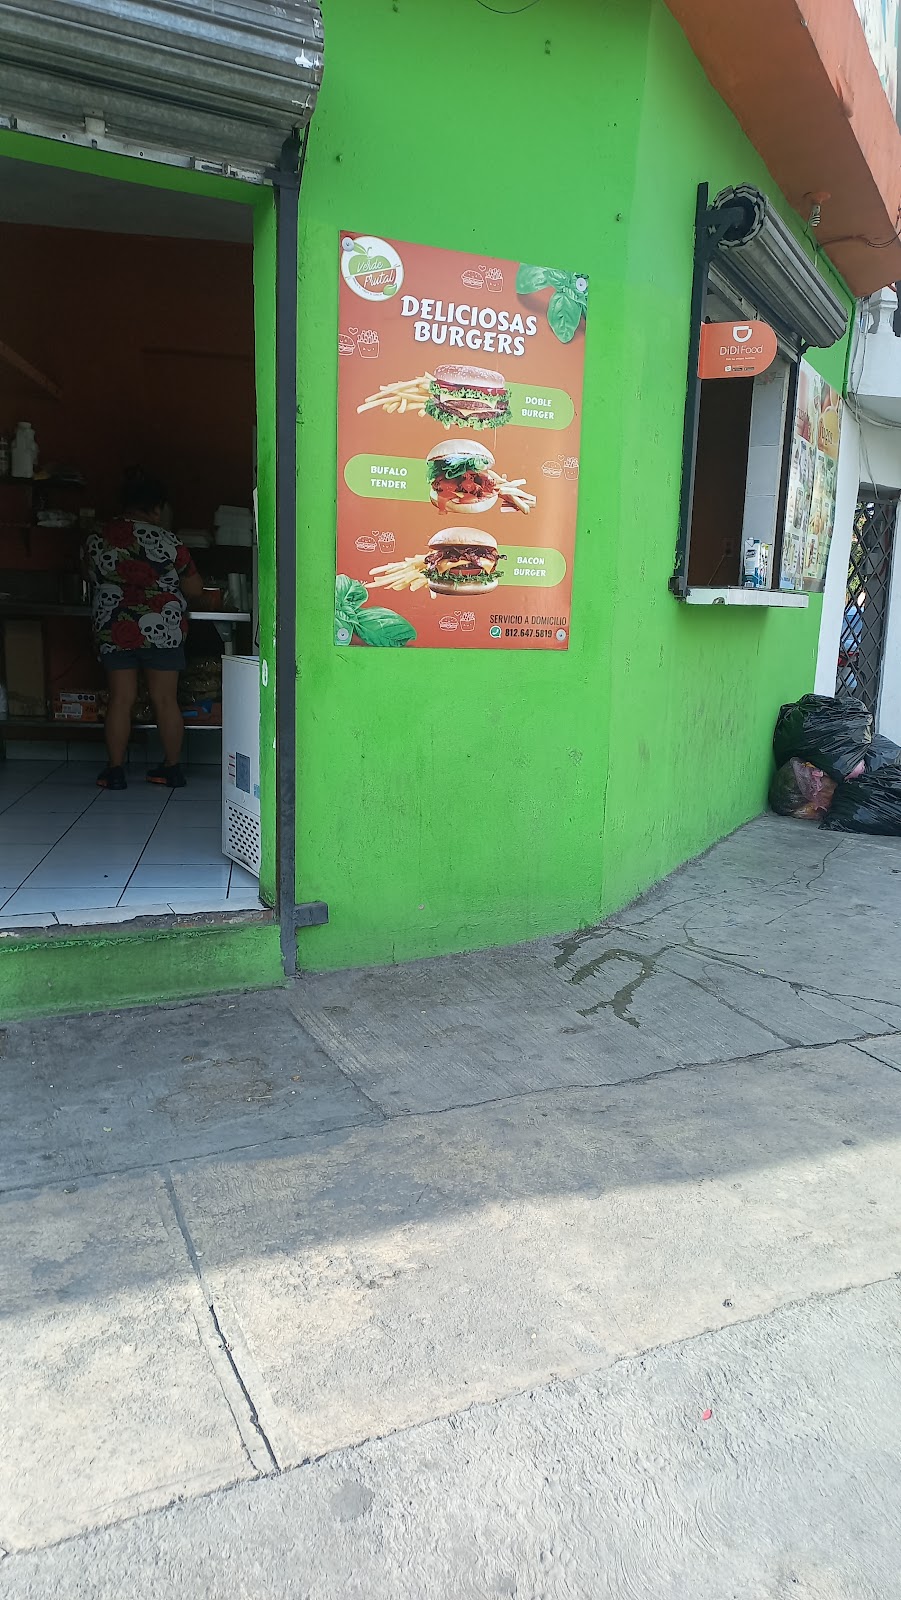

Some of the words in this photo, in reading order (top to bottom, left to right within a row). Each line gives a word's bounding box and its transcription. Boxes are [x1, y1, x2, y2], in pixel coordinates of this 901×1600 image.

[357, 259, 383, 273] Verde
[363, 269, 395, 288] Frutal
[400, 295, 538, 336] DELICIOSAS
[413, 321, 525, 356] BURGERS
[525, 396, 553, 408] DOBLE
[521, 408, 555, 420] BURGER
[370, 465, 408, 477] BUFALO
[370, 478, 407, 490] TENDER
[516, 556, 545, 566] BACON
[513, 568, 547, 578] BURGER
[489, 614, 523, 625] SERVICIO
[524, 615, 530, 625] A
[531, 615, 567, 626] DOMICILIO
[504, 627, 553, 638] 812.647.5819
